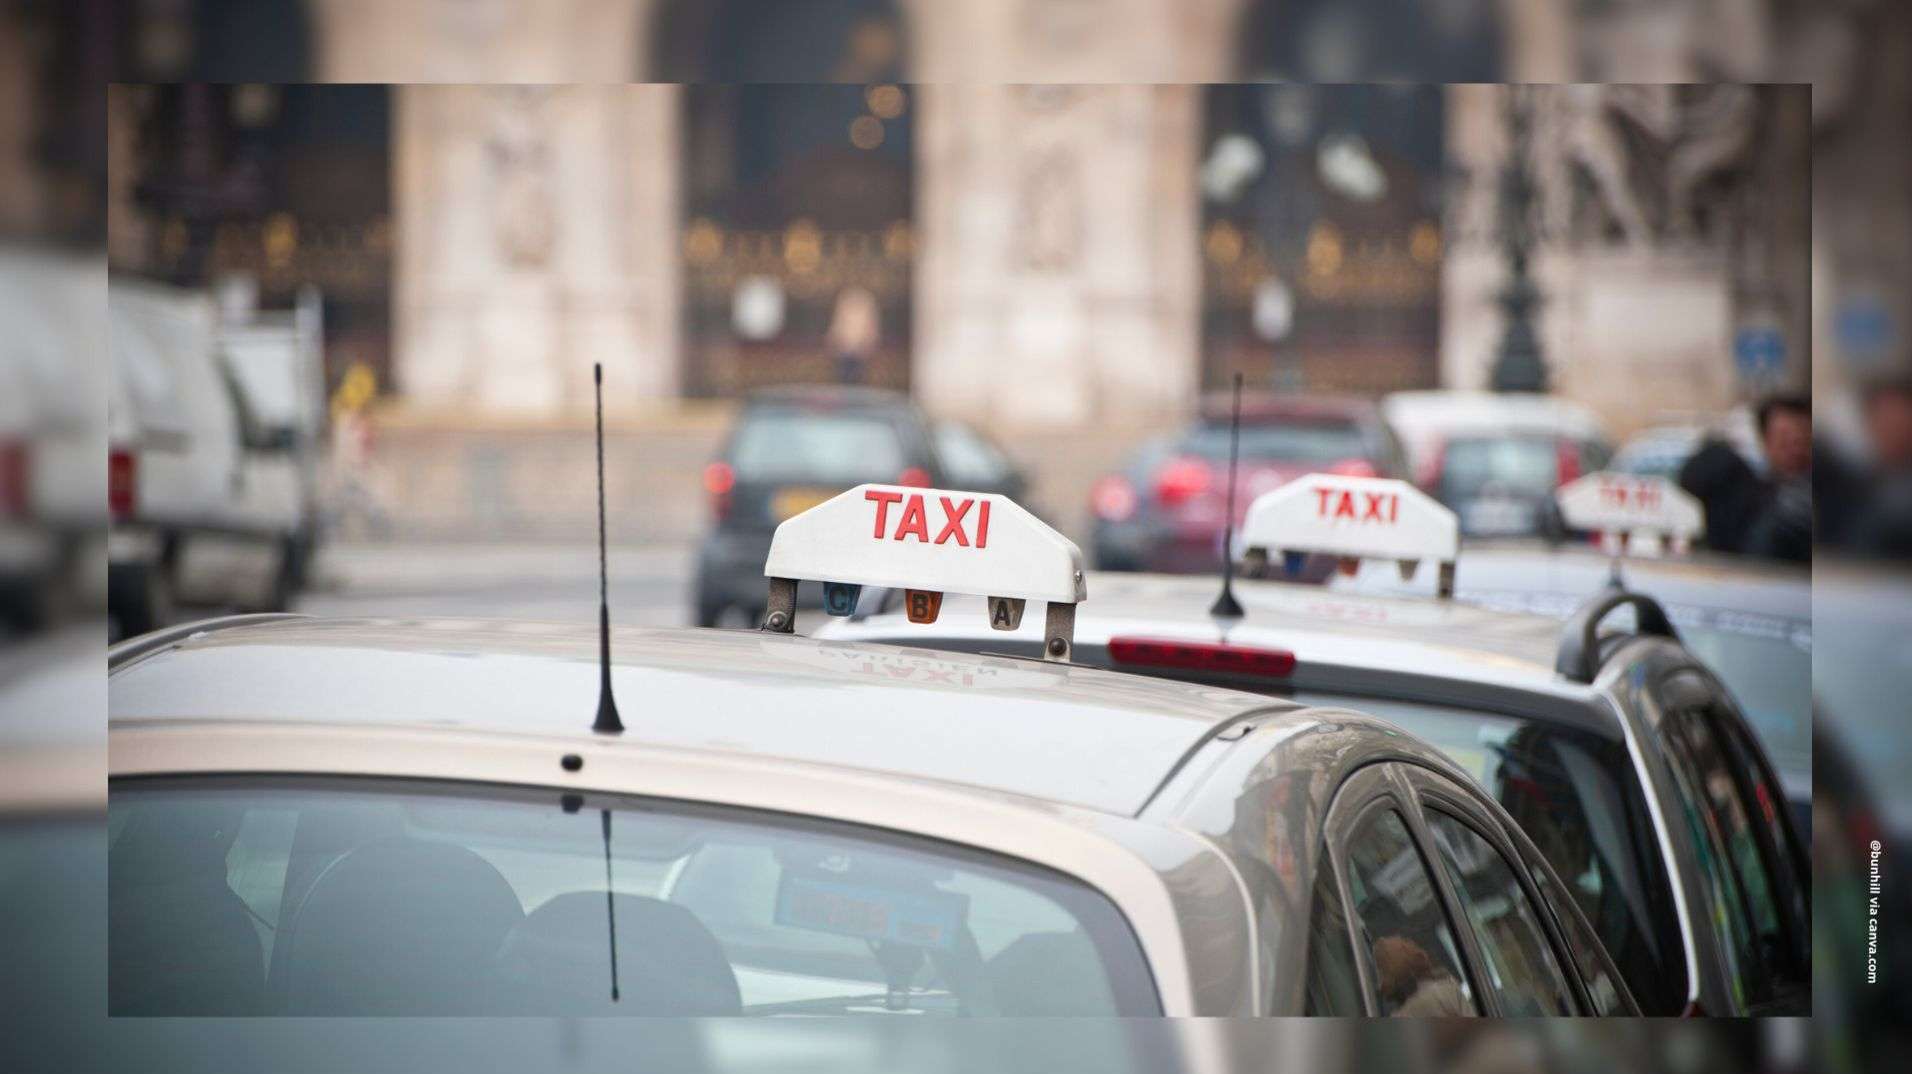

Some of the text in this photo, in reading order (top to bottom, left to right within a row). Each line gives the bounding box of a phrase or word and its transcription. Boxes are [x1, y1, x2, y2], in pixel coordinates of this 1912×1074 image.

[864, 490, 992, 549] TAXI
[1314, 487, 1399, 525] TAXI
[828, 586, 1011, 627] C B A
